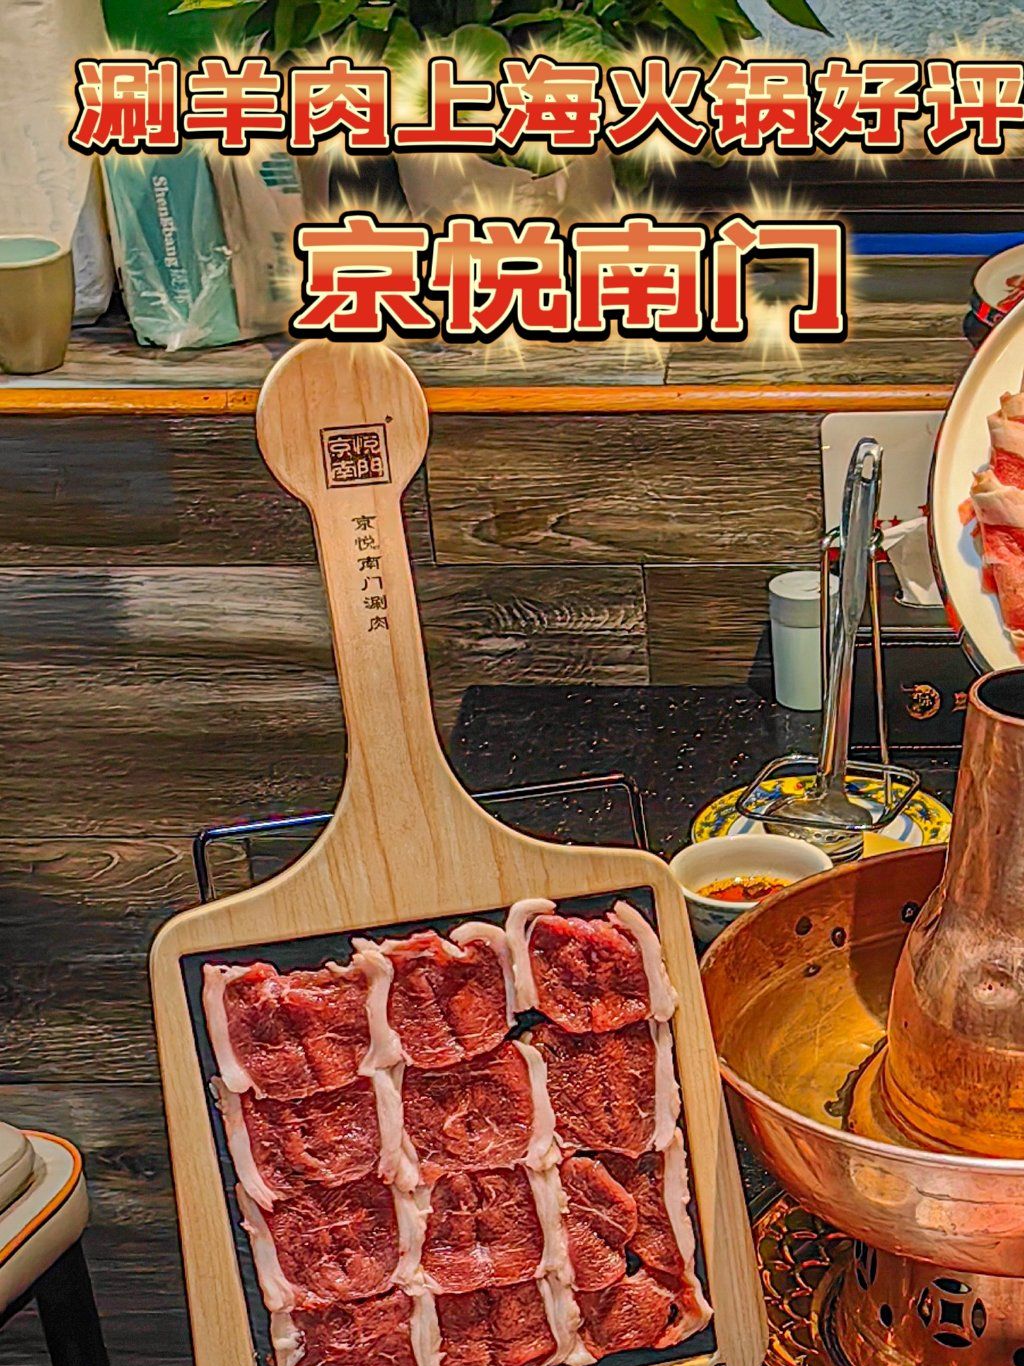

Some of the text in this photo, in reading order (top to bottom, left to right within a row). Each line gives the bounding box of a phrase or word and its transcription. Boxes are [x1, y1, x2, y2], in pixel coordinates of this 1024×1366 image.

[352, 514, 390, 632] 京悦南门涮肉
